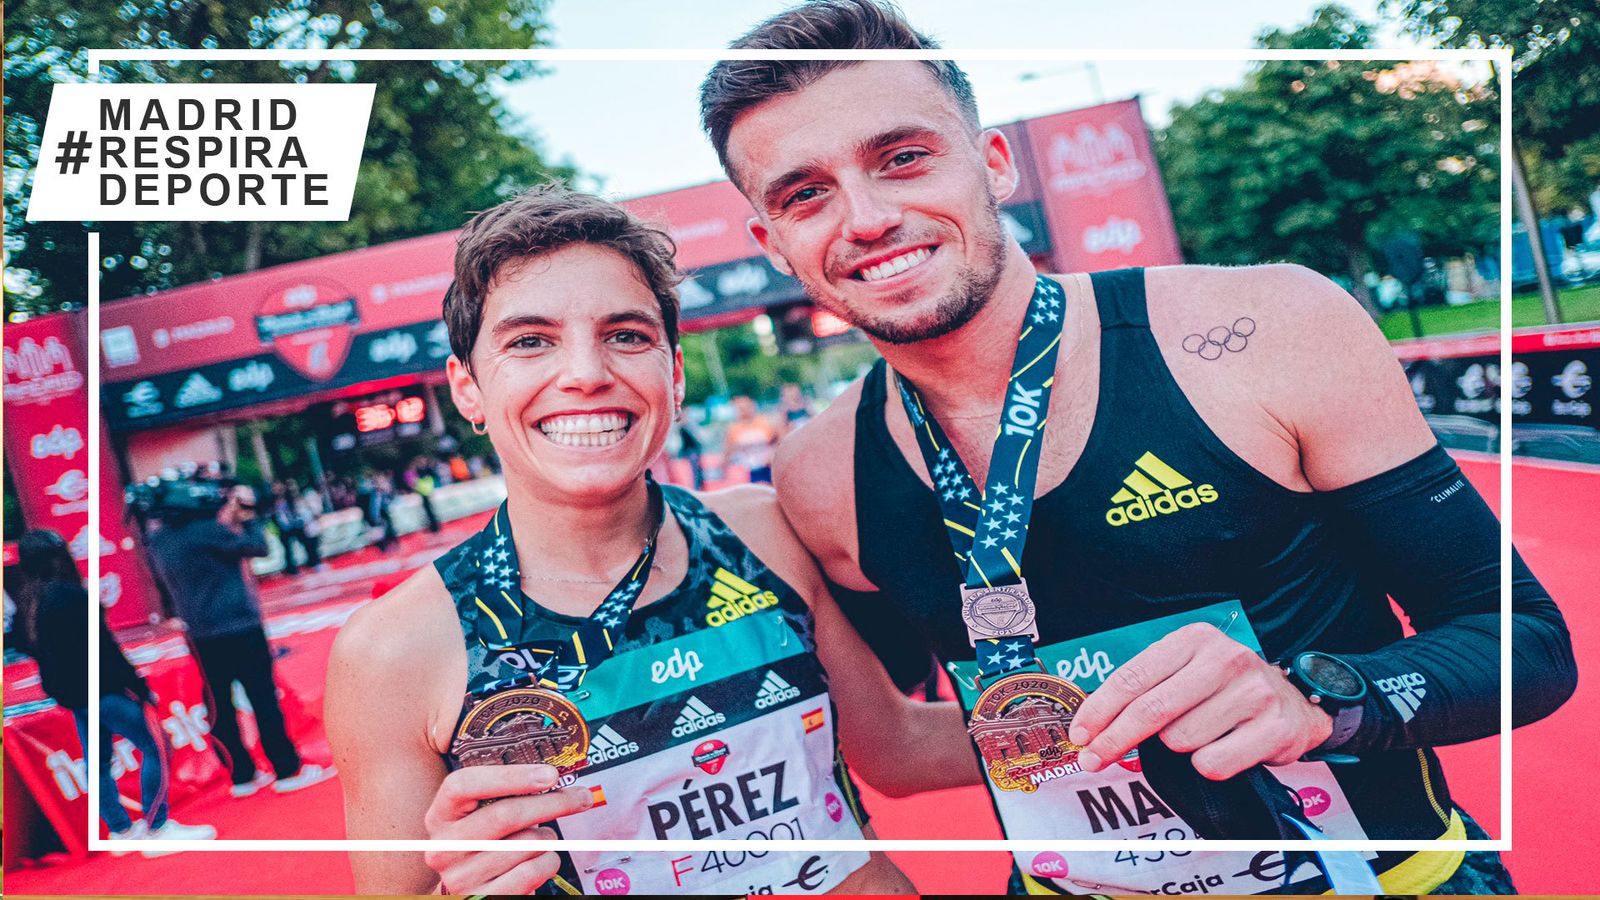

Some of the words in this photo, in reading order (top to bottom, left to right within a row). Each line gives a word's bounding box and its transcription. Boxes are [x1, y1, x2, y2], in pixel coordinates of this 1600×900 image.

[1005, 381, 1043, 437] 10K
[1105, 482, 1219, 526] adidas
[705, 590, 779, 627] adidas
[651, 648, 704, 684] edp
[1056, 648, 1115, 683] edp
[1012, 680, 1049, 691] 2020
[1372, 672, 1426, 694] adida
[502, 696, 541, 707] 2020
[754, 686, 801, 709] adidas
[671, 712, 726, 738] adidas
[1030, 761, 1084, 785] MADRI
[648, 760, 799, 840] PÉREZ
[671, 854, 694, 887] F
[701, 816, 805, 873] 40001
[1034, 860, 1064, 873] 10K
[597, 877, 626, 890] 10K
